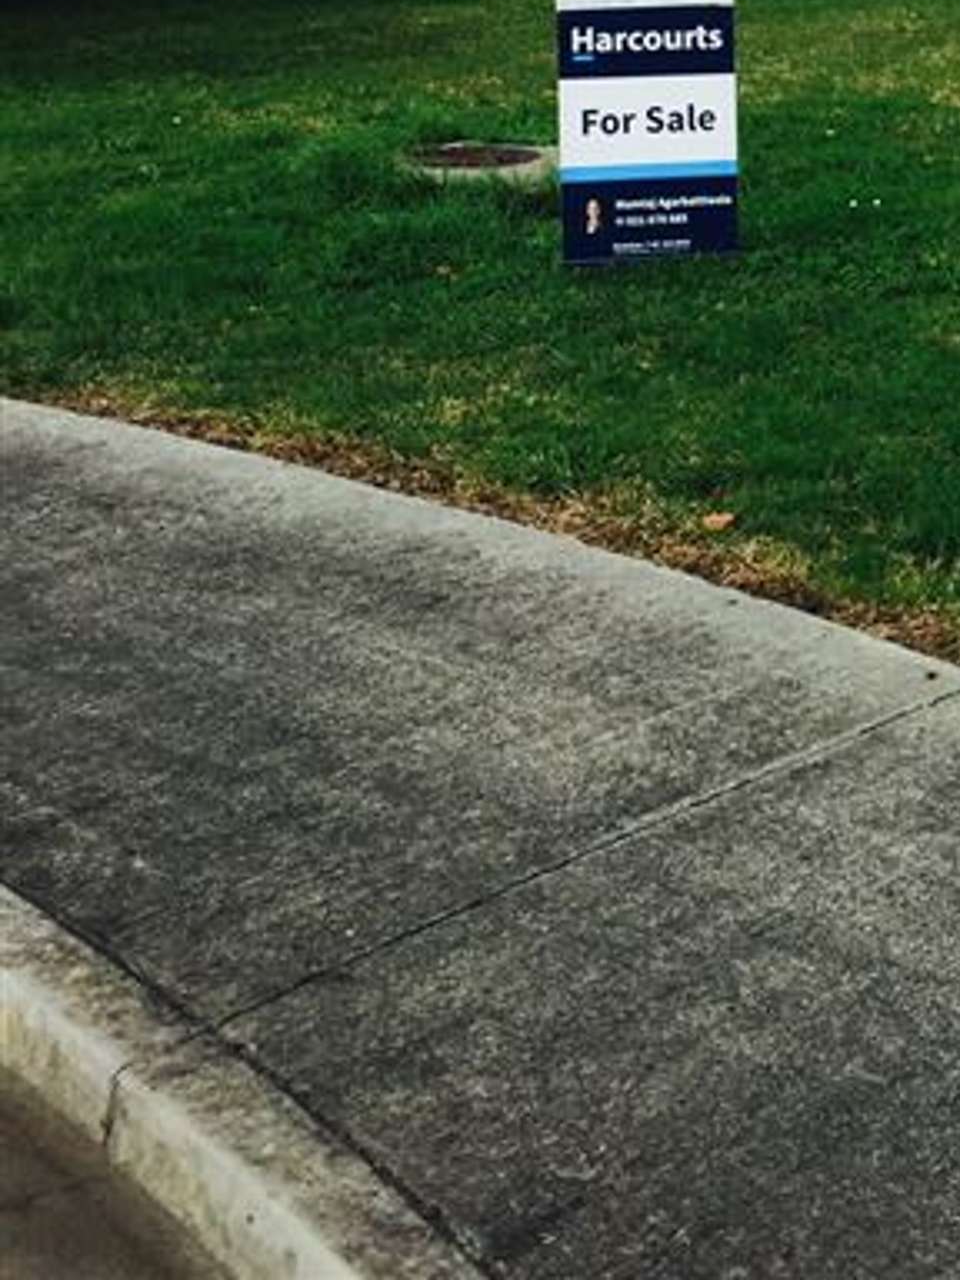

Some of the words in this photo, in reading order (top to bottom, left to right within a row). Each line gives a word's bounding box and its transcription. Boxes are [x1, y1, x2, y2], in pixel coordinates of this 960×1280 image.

[571, 25, 723, 53] Harcourts
[581, 109, 636, 135] For
[645, 103, 717, 134] Sale
